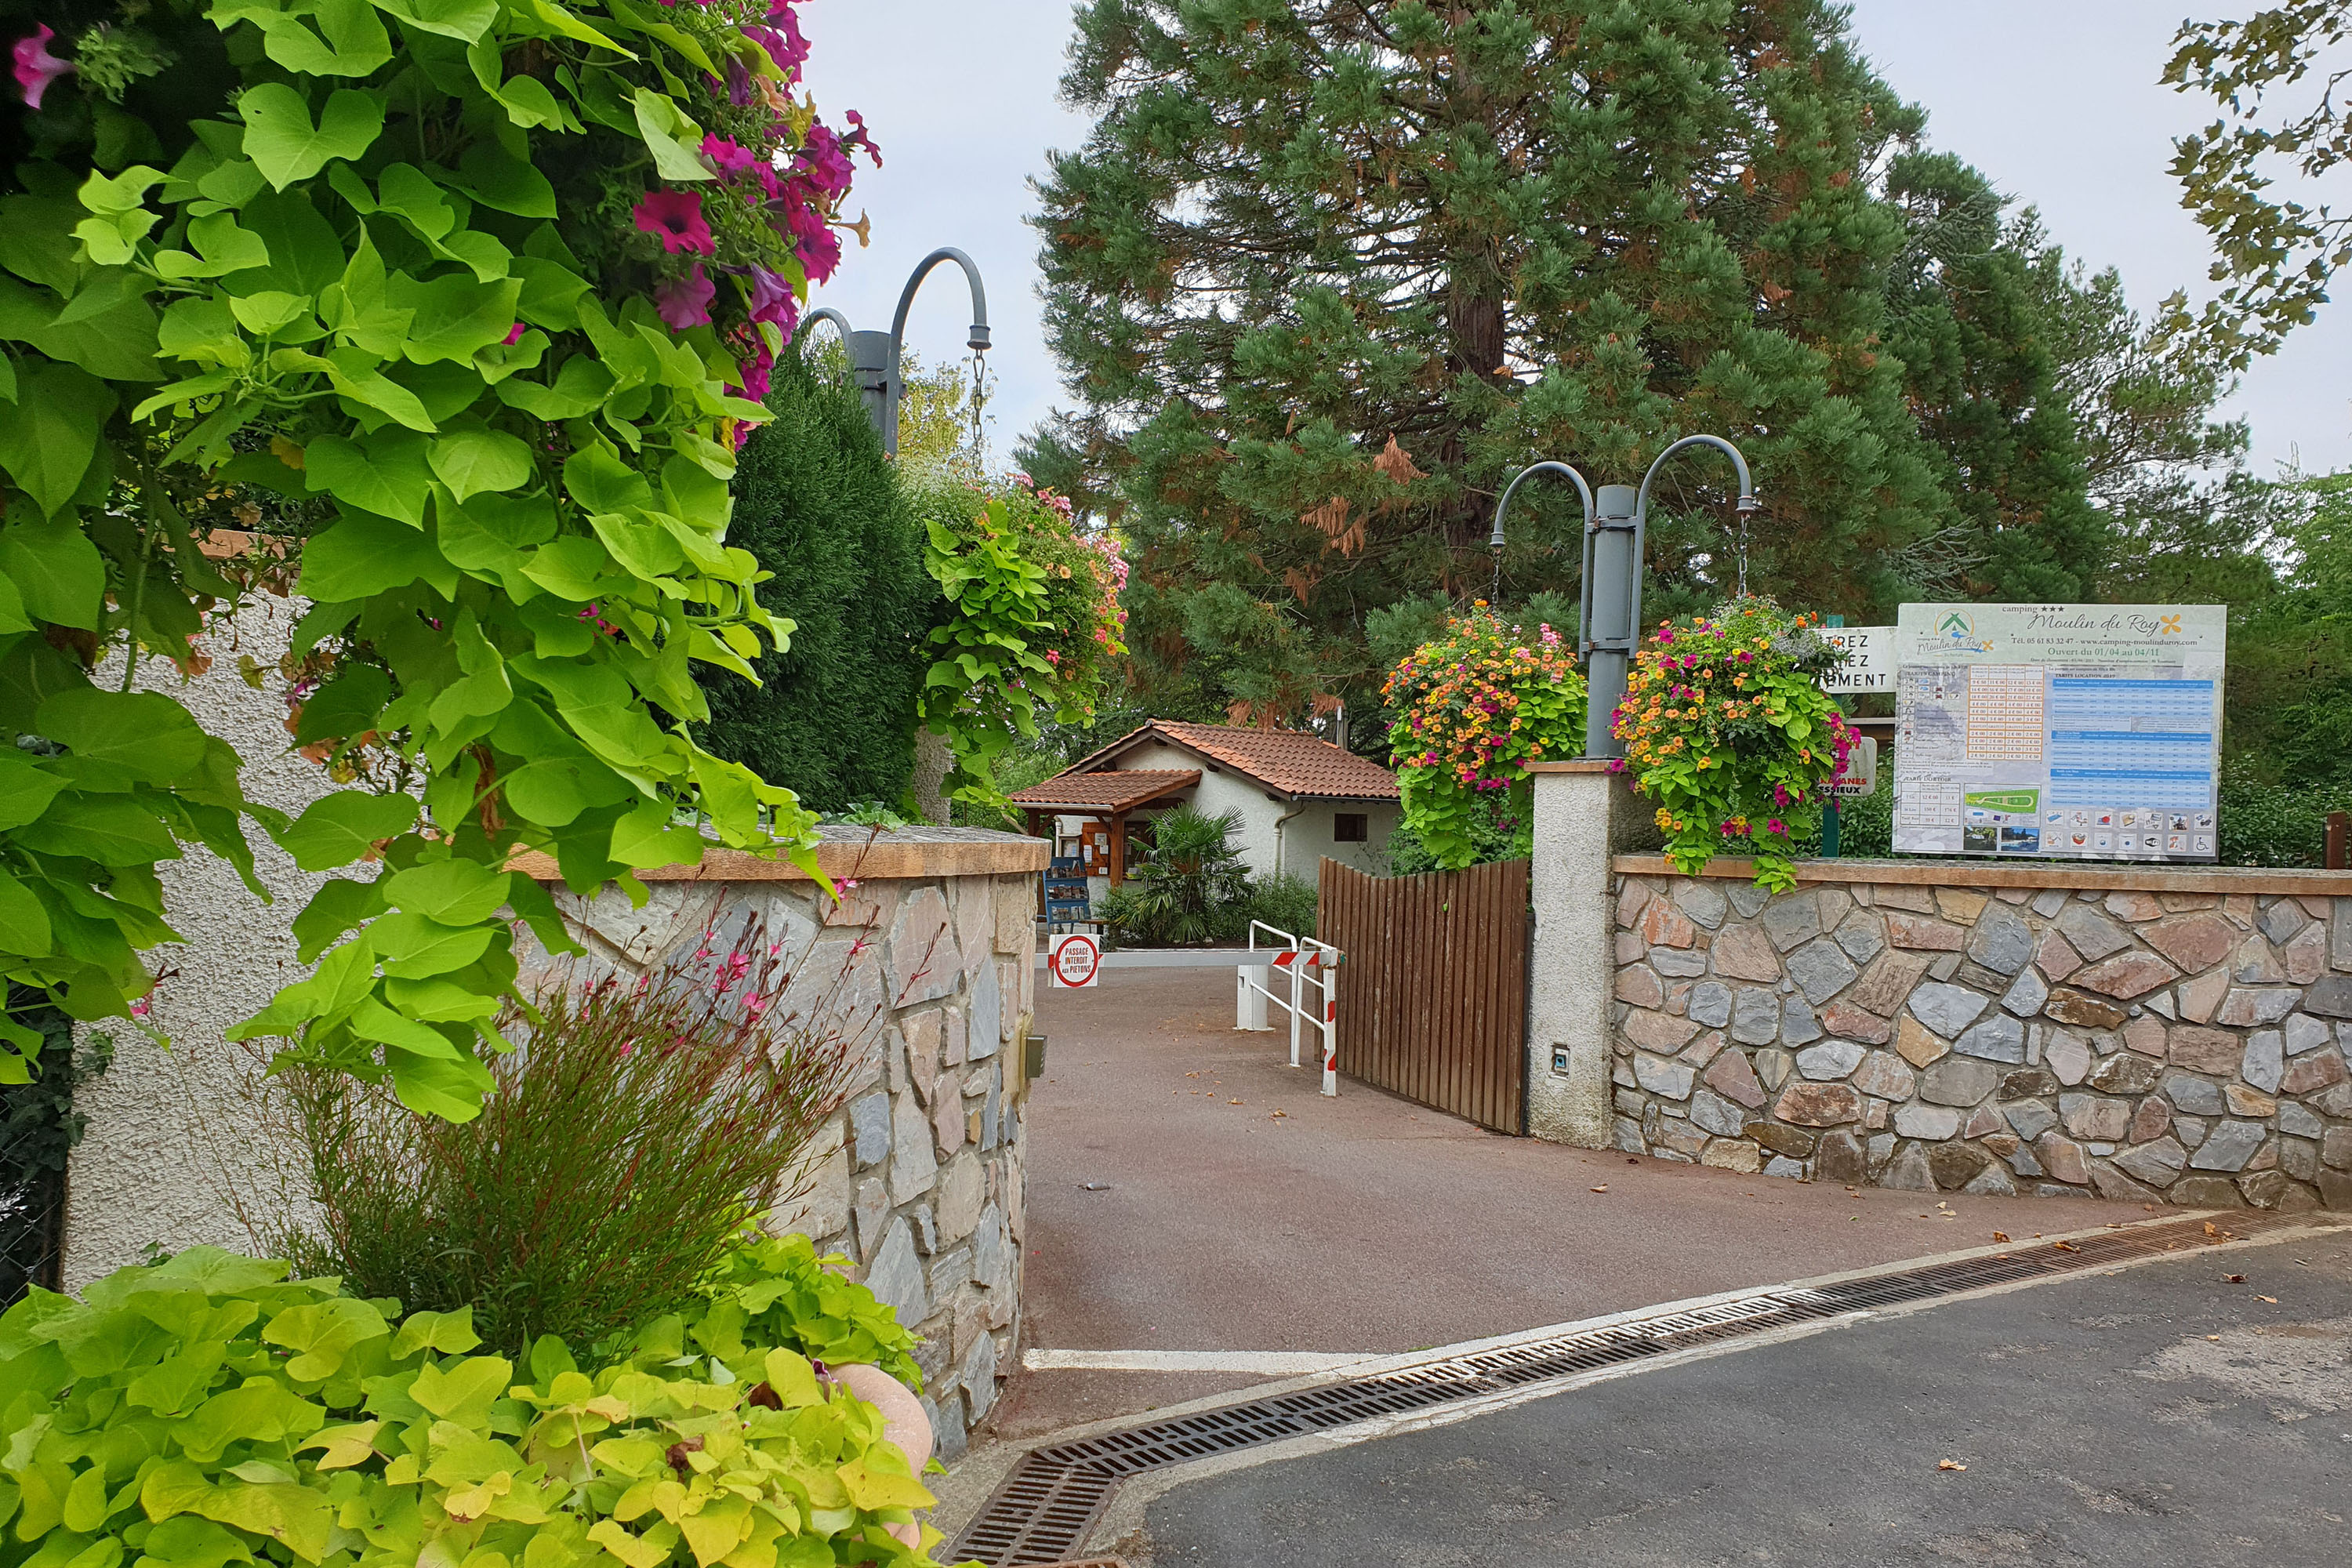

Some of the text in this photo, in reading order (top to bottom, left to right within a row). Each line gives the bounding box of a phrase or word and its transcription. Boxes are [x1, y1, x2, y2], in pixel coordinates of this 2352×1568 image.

[2002, 605, 2038, 613] camping
[2027, 614, 2161, 637] Moulin du Roy
[1917, 637, 1982, 655] Moulin du Roy
[2080, 639, 2197, 647] www.camping-moulinduroy.com
[2095, 648, 2119, 657] 01/04
[2135, 648, 2159, 657] 04/11
[1065, 947, 1089, 955] PASSAGE
[1065, 956, 1088, 965] INTERDIT
